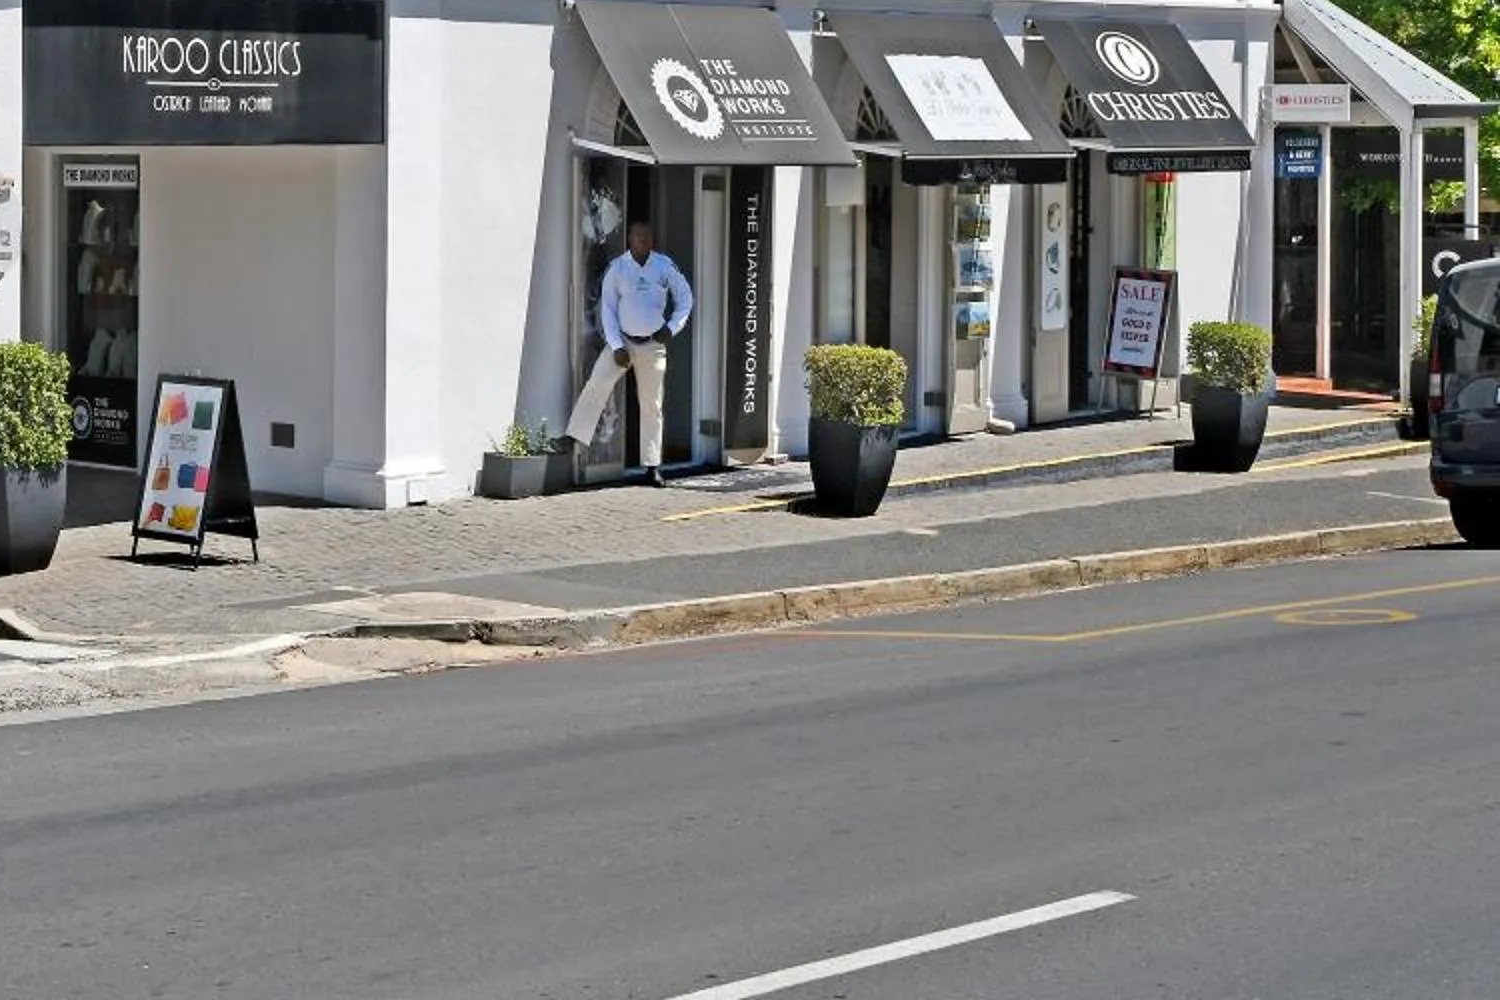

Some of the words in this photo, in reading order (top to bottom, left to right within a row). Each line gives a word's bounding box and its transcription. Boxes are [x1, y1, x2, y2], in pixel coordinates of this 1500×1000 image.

[123, 35, 209, 75] KAROO
[218, 39, 302, 76] CLASSICS
[700, 58, 738, 76] THE
[709, 78, 792, 96] DIAMOND
[719, 96, 787, 115] WORKS
[1088, 91, 1232, 121] CHRISTIES
[747, 193, 759, 233] THE
[745, 239, 758, 333] DIAMOND
[1120, 284, 1162, 302] SALE
[743, 338, 757, 414] WORKS
